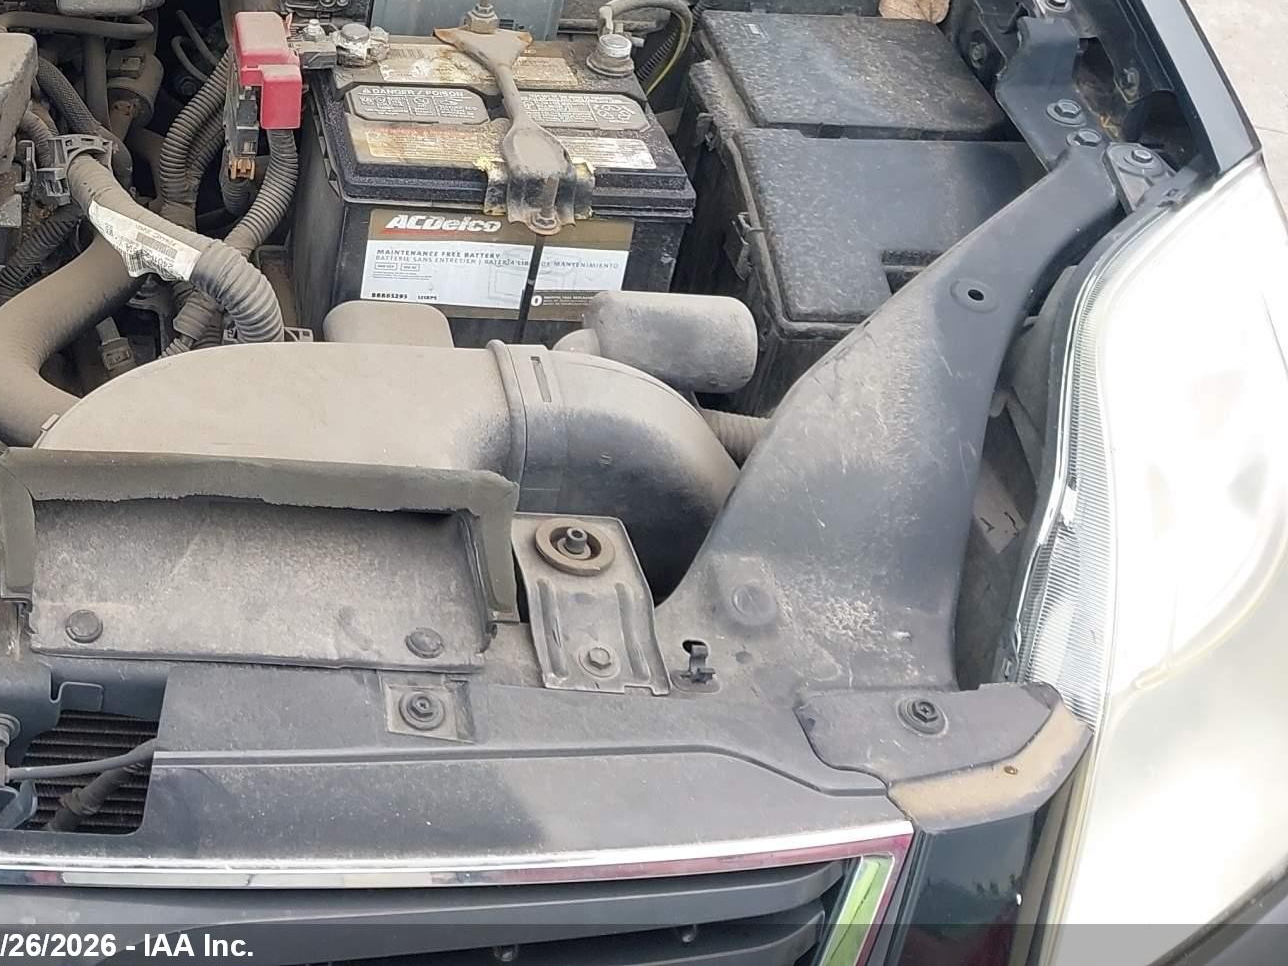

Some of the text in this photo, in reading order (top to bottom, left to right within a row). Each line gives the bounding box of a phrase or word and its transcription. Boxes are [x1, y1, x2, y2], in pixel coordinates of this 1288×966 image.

[371, 88, 414, 96] DANGER
[385, 214, 502, 233] ACDelco
[376, 249, 438, 257] MAINTENANCE
[441, 250, 461, 258] FREE
